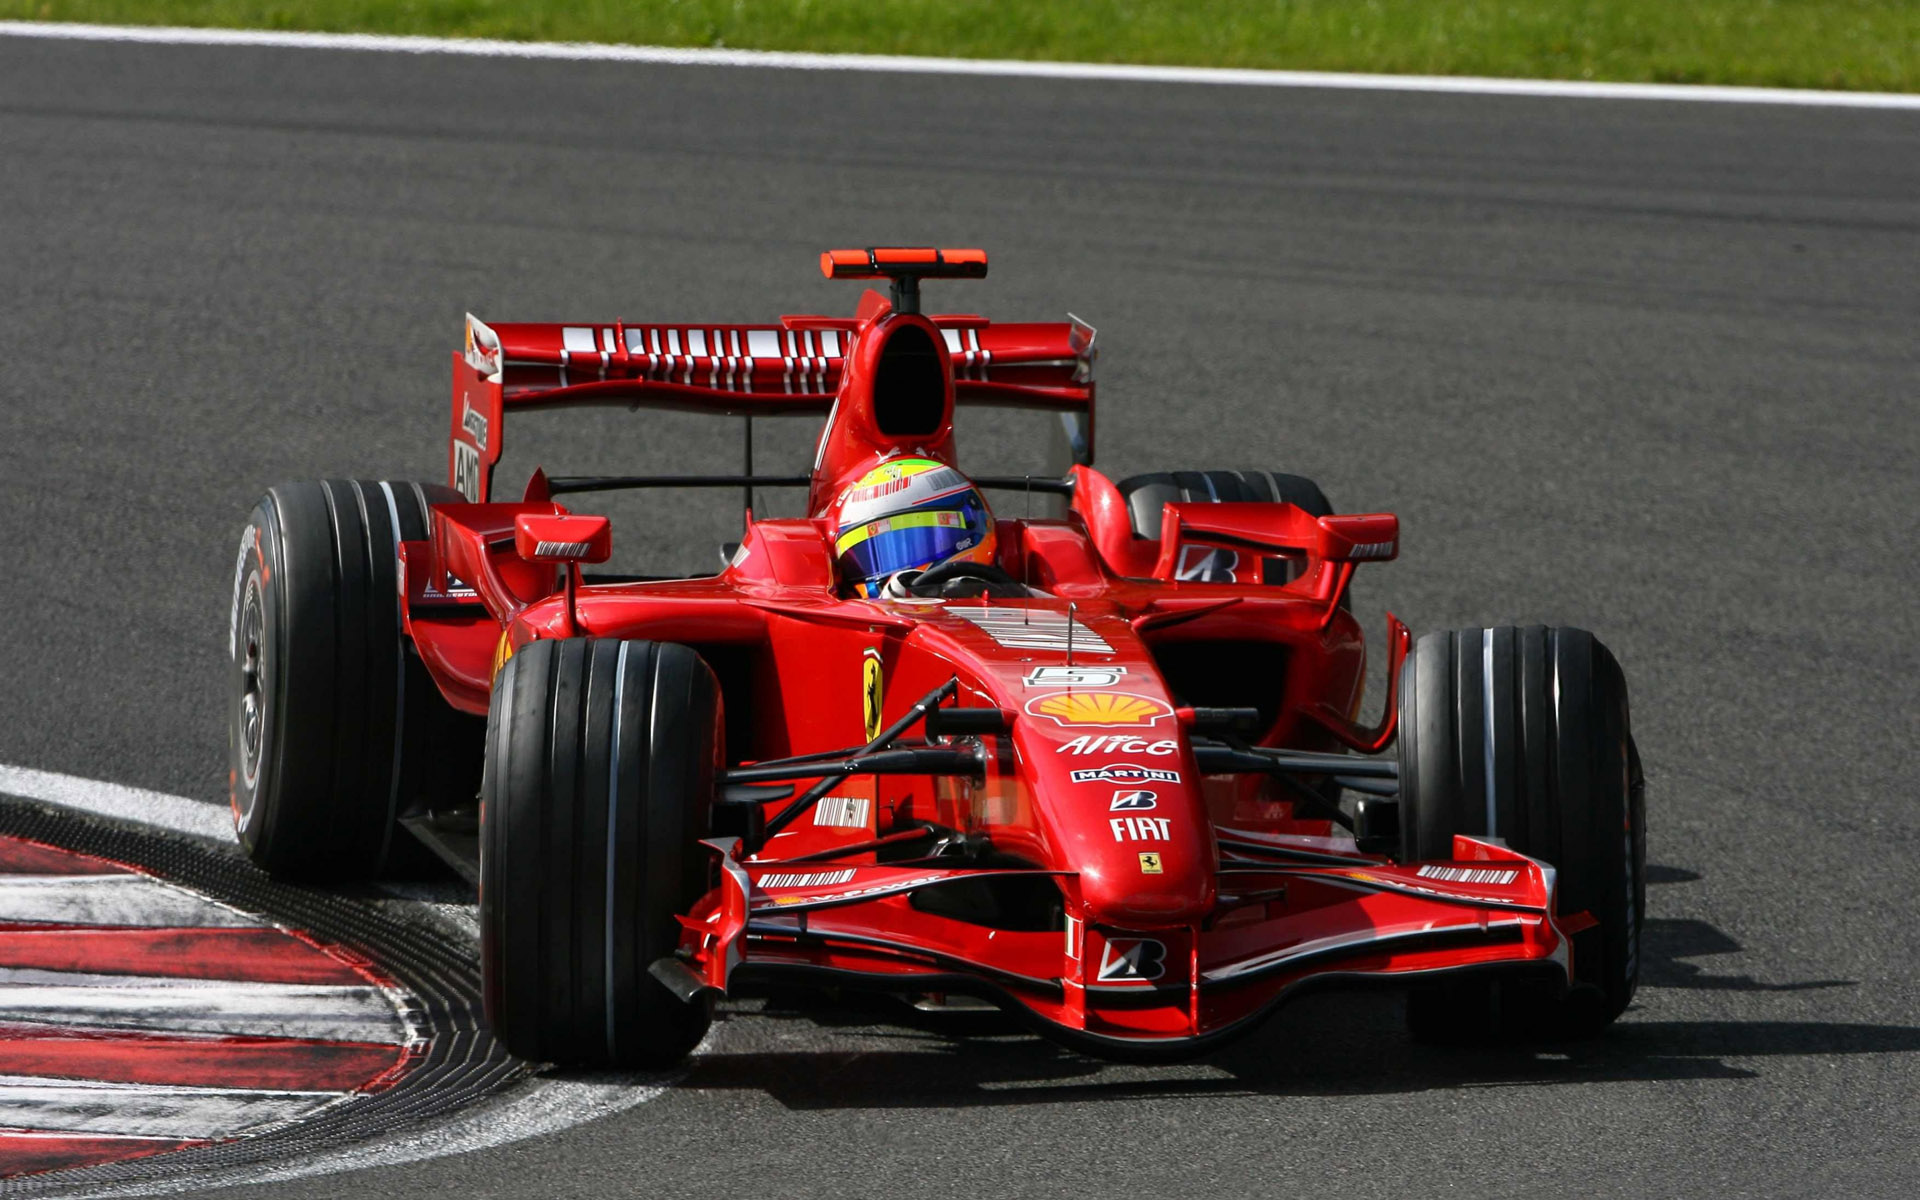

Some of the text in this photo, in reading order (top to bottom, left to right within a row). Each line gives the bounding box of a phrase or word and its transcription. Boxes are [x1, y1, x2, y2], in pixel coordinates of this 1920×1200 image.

[1022, 666, 1128, 688] 5
[1056, 735, 1179, 755] Alice
[1080, 770, 1173, 780] MARTINI
[1109, 817, 1171, 842] FIAT
[809, 875, 941, 901] V-Power
